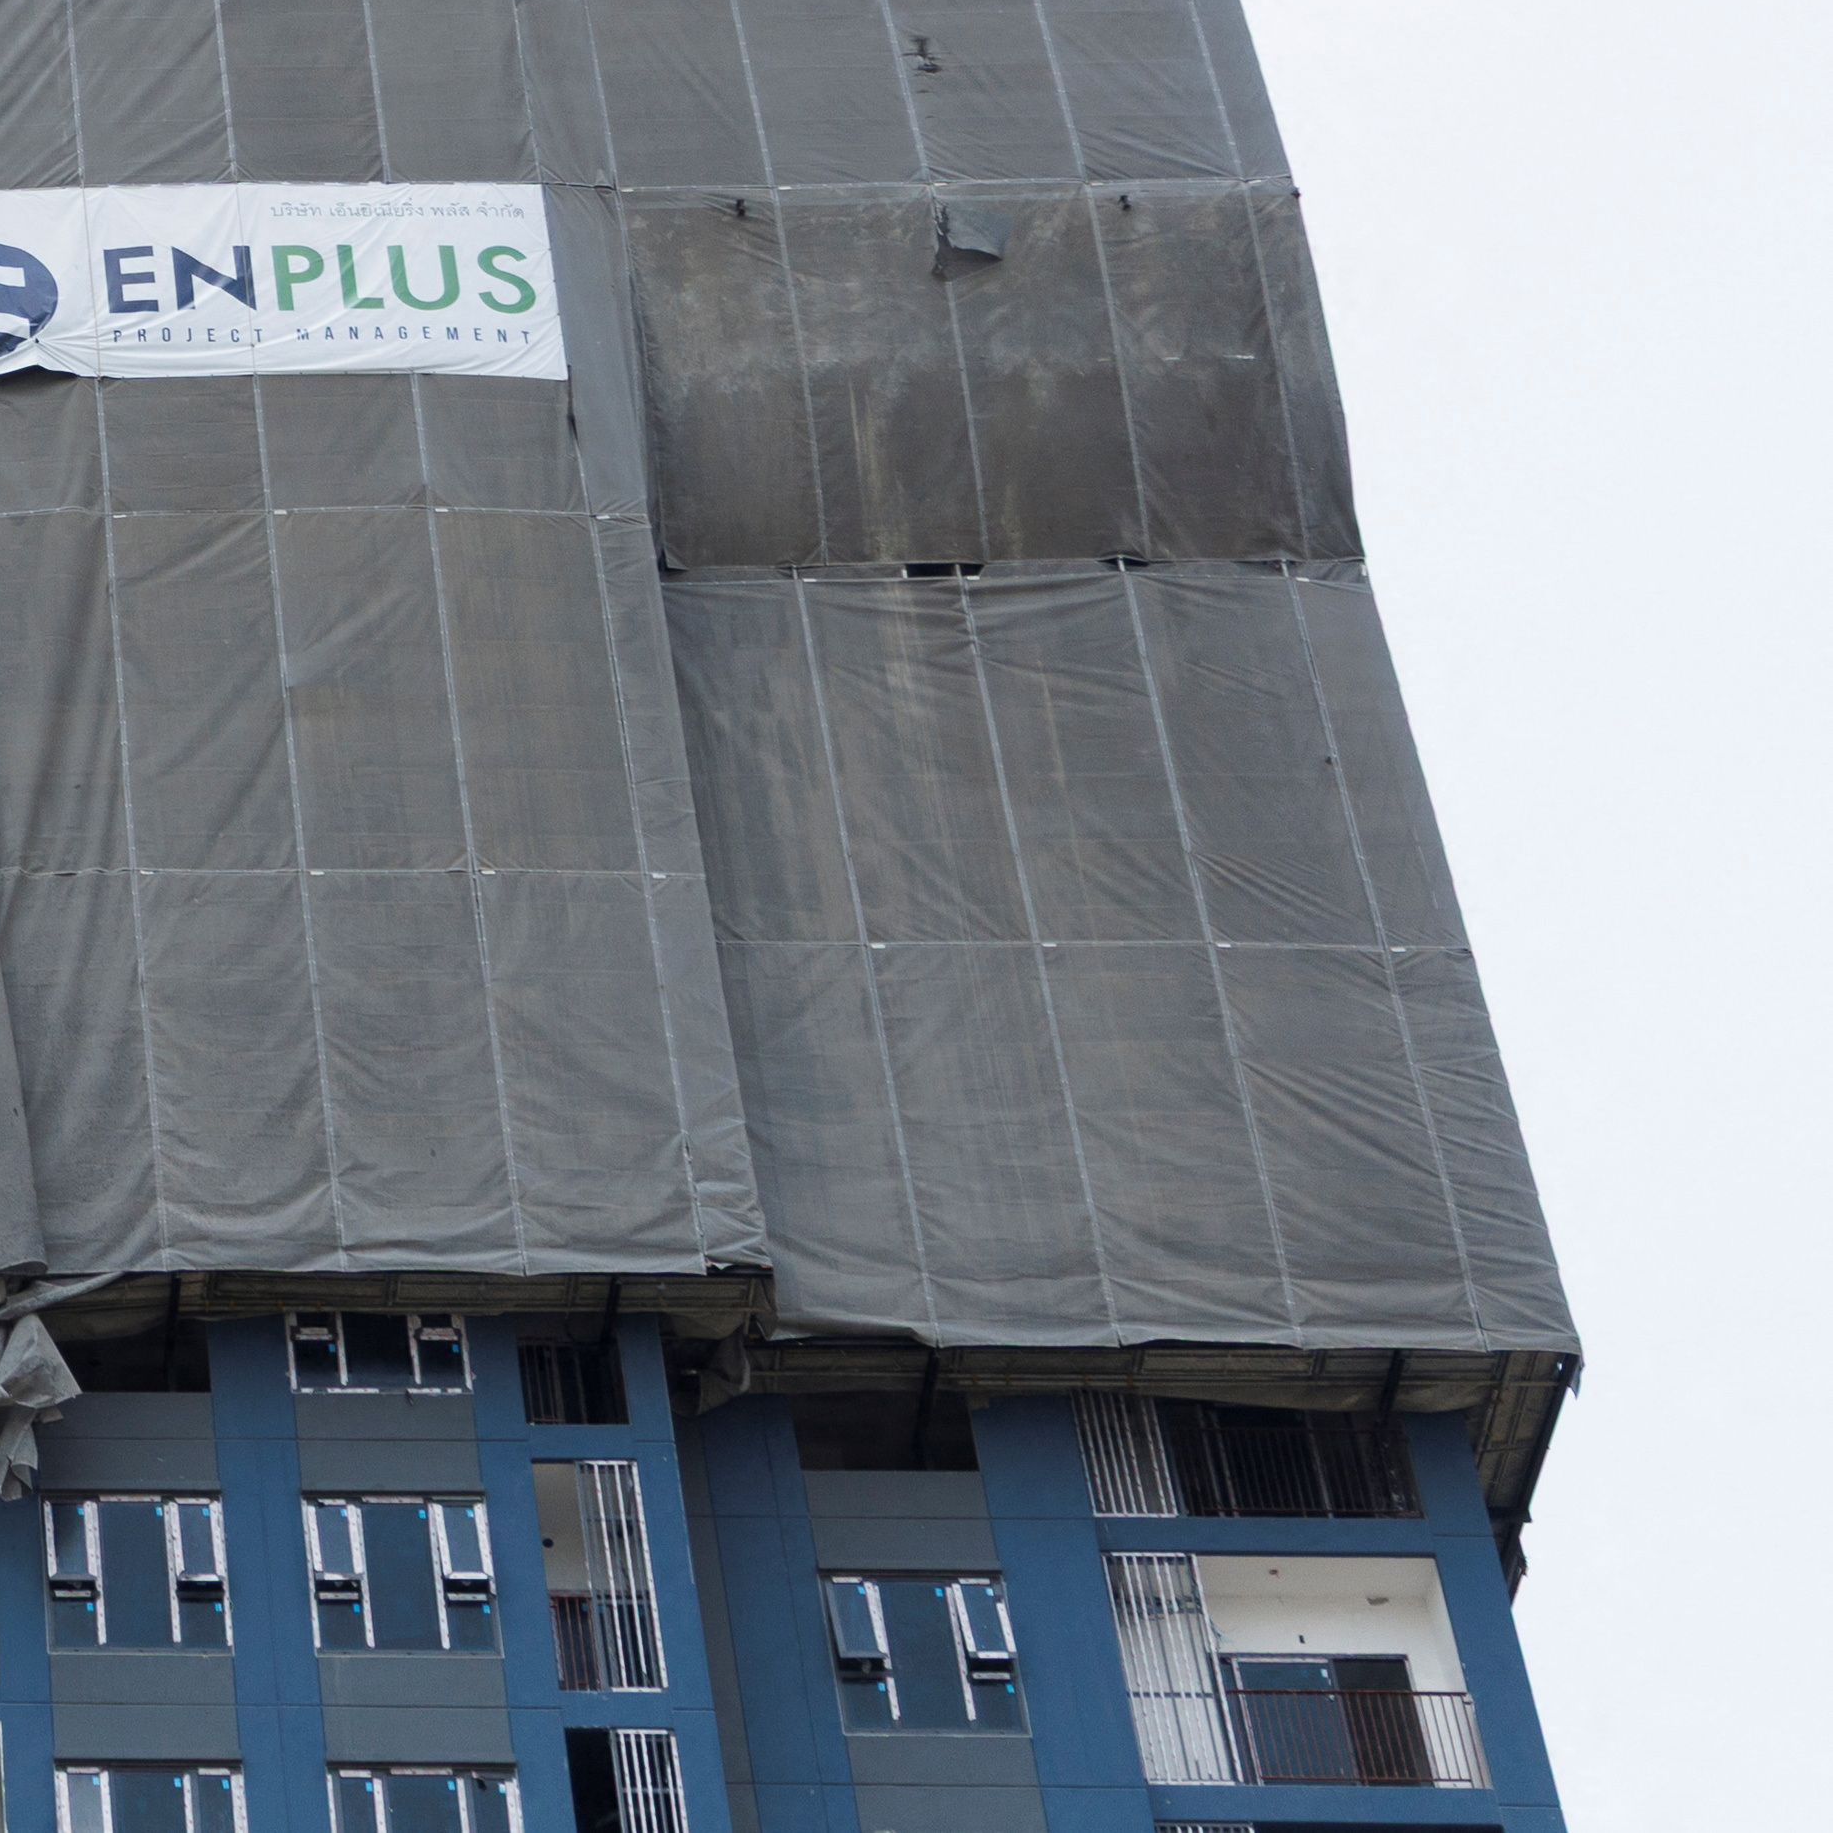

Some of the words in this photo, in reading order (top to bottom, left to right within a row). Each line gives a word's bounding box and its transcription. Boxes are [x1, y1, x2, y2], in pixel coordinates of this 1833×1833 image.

[270, 202, 322, 217] บริษัท
[430, 202, 471, 217] พลัส
[476, 201, 525, 219] จำกัด
[104, 244, 536, 314] ENPLUS
[113, 327, 263, 343] PROJECT
[296, 326, 531, 345] MANAGEMENT
